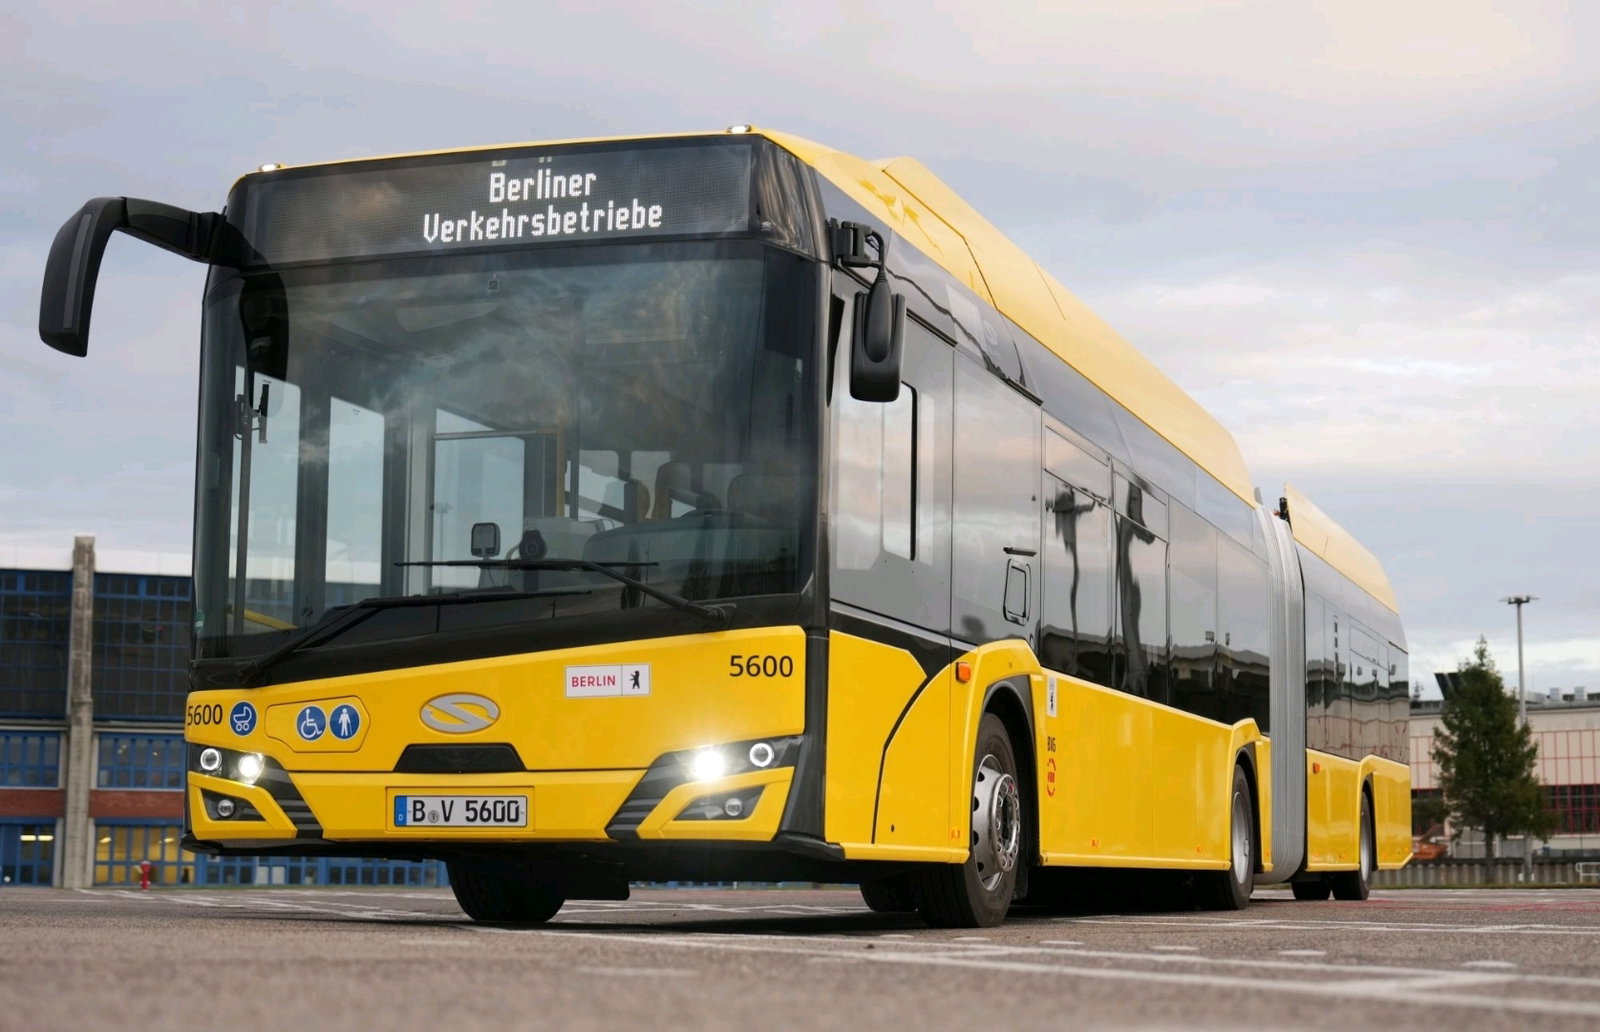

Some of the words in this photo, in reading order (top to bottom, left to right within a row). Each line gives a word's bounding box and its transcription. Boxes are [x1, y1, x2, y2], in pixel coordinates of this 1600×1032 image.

[489, 168, 597, 202] Berliner
[424, 198, 662, 243] Verkehrsbetriebe
[729, 655, 794, 678] 5600
[571, 674, 616, 688] BERLIN
[186, 703, 223, 726] 5600
[412, 799, 426, 822] B
[441, 799, 455, 822] V
[465, 799, 520, 823] 5600
